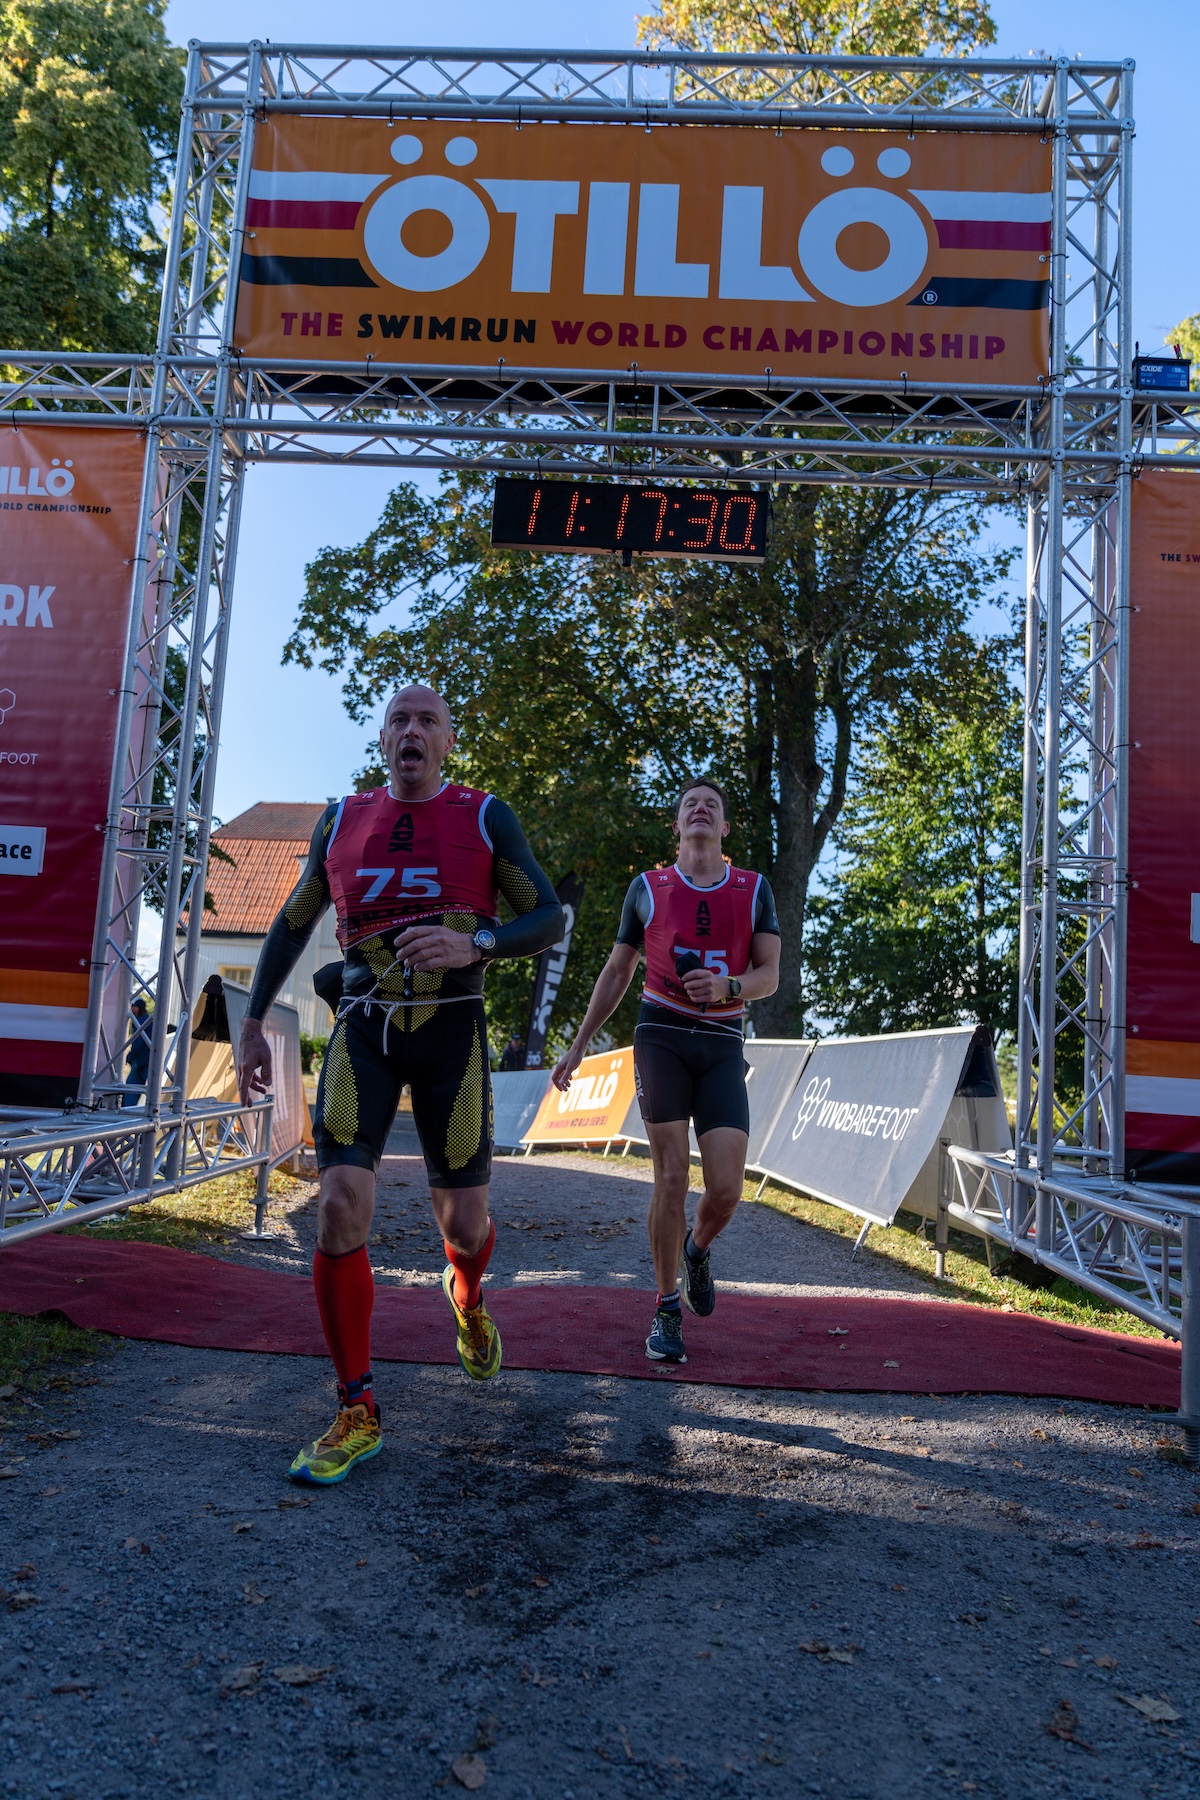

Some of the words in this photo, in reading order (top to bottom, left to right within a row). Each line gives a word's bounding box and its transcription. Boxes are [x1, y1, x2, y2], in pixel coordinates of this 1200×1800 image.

[364, 134, 929, 307] ÖTILLÖ
[280, 312, 344, 337] THE
[357, 313, 537, 344] SWIMRUN
[552, 320, 686, 349] WORLD
[703, 325, 1006, 361] CHAMPIONSHIP
[1140, 364, 1163, 373] EXIDE
[27, 503, 112, 515] CHAMPIONSHIP
[1160, 553, 1182, 562] THE
[0, 584, 57, 629] RK
[0, 751, 39, 765] FOOT
[362, 791, 375, 799] 75
[0, 843, 32, 860] ace
[355, 866, 442, 903] 75
[392, 915, 417, 924] WORLD
[419, 908, 474, 919] CHAMPIONSHIP
[816, 1100, 919, 1141] VIVOBAREFOOT
